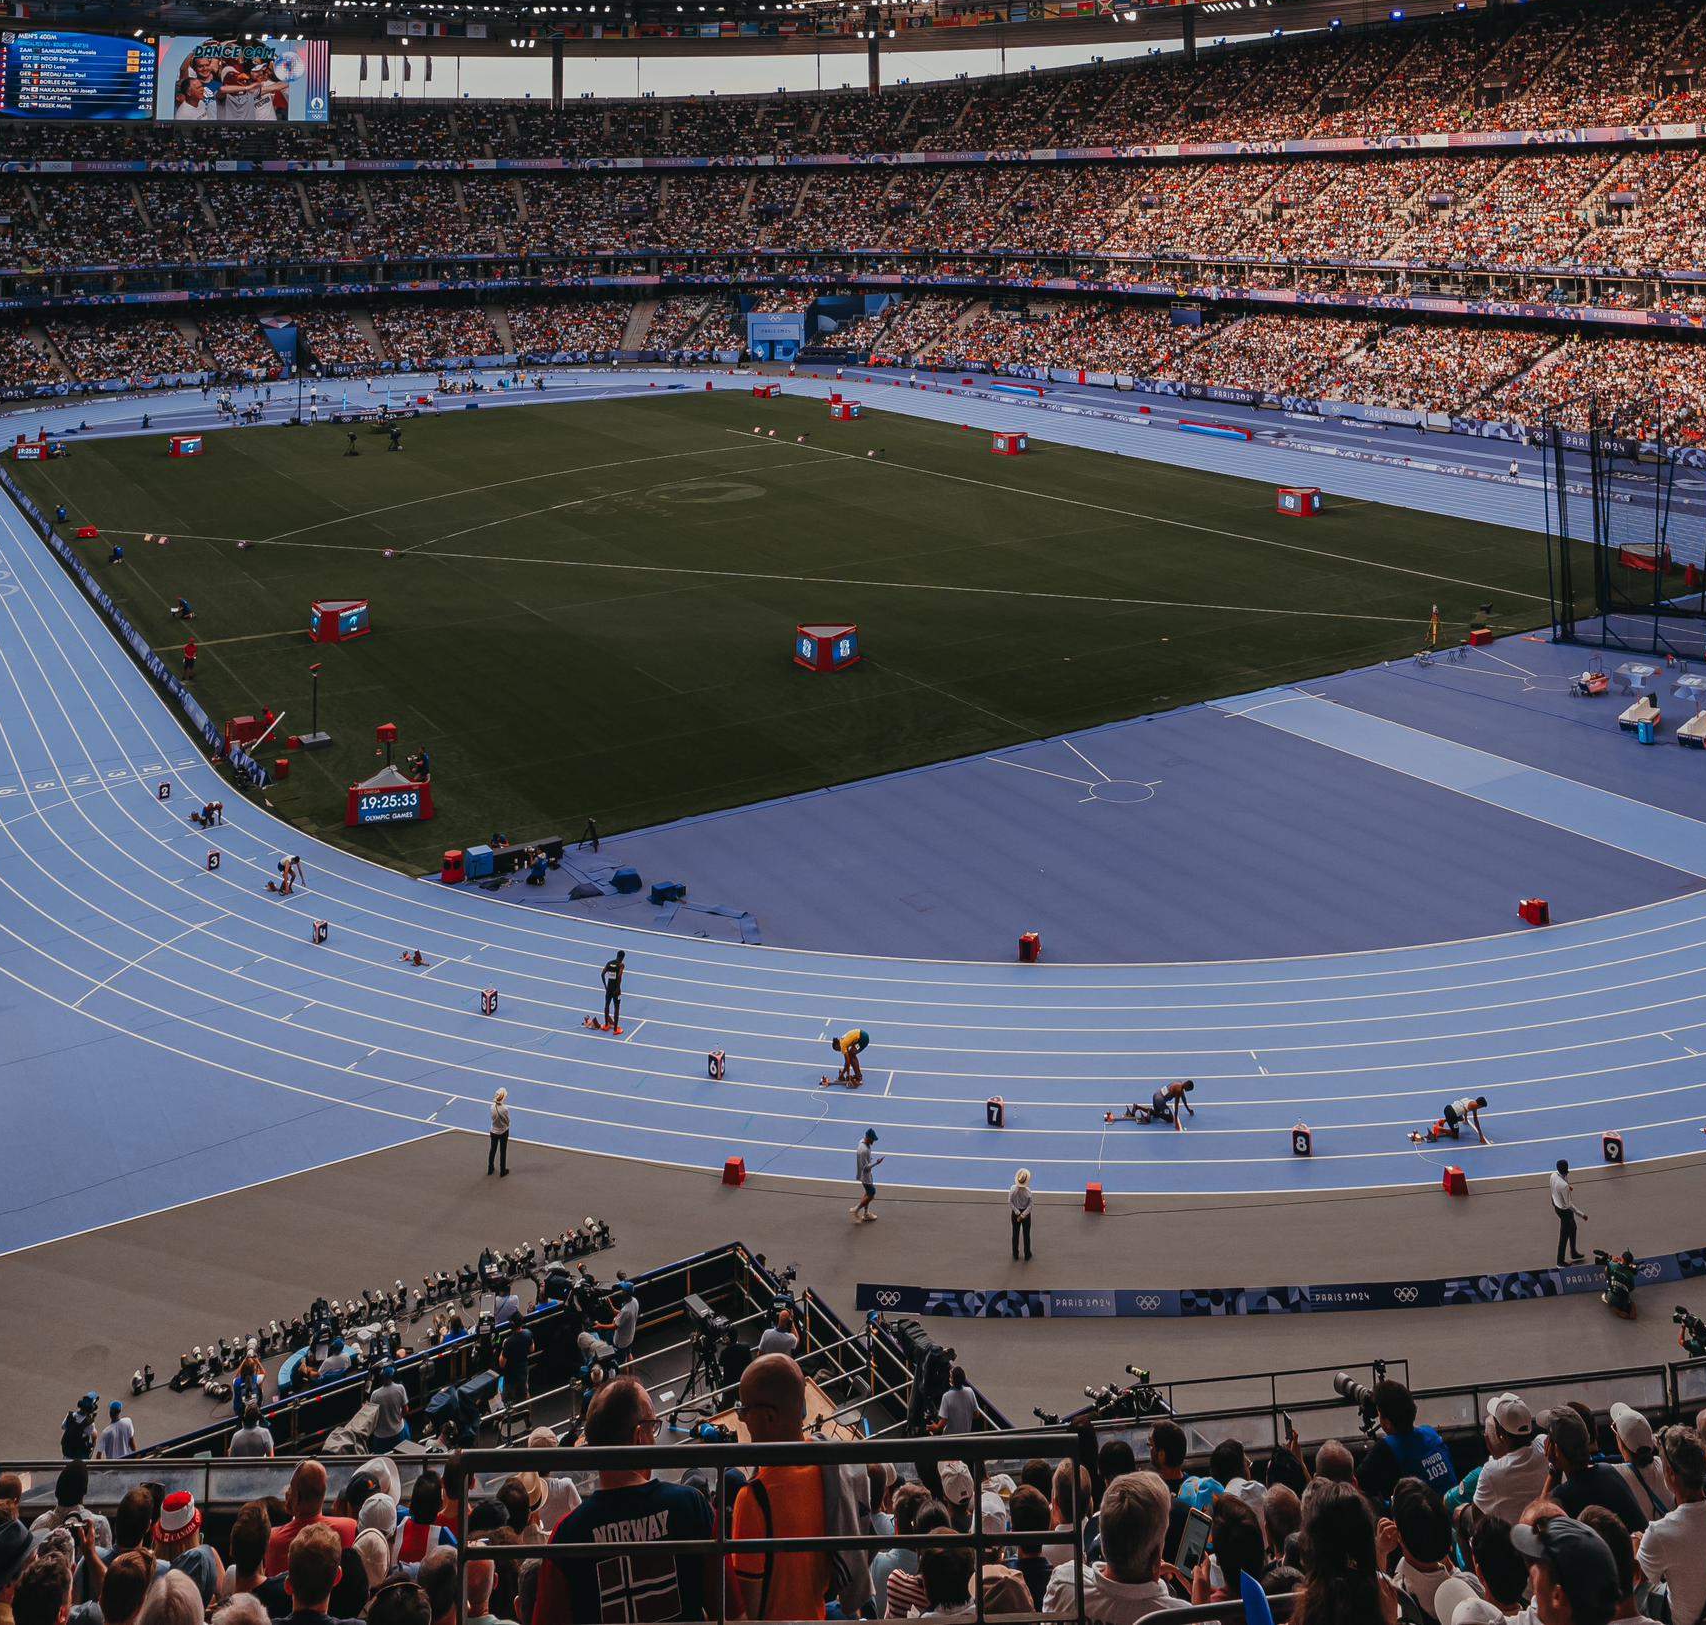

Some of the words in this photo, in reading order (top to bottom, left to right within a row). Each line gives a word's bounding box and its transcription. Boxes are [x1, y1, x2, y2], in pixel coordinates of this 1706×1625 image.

[193, 45, 241, 58] DANCE
[244, 46, 277, 59] CAM
[1421, 301, 1441, 309] PARIS
[1442, 302, 1460, 310] 2024
[1594, 311, 1615, 320] PARIS
[1617, 313, 1636, 321] 2024
[1213, 390, 1235, 399] PARIS
[1236, 392, 1253, 401] 2024
[1364, 409, 1389, 419] PARIS
[1390, 412, 1412, 422] 2024
[161, 786, 169, 797] 2
[360, 792, 418, 811] 19:25:33
[365, 812, 391, 823] OLYMPIC
[391, 811, 414, 821] GAMES
[210, 856, 219, 868] 3
[320, 928, 328, 938] 4
[709, 1060, 718, 1075] 6
[989, 1106, 999, 1122] 7
[1295, 1135, 1308, 1152] 8
[1606, 1142, 1619, 1159] 9
[1565, 1274, 1592, 1286] PARIS
[1055, 1298, 1083, 1308] PARIS
[1085, 1298, 1112, 1308] 2024
[1315, 1293, 1343, 1303] PARIS
[1344, 1292, 1371, 1302] 2024
[1421, 1452, 1443, 1468] PHOTO
[1426, 1462, 1448, 1481] 1033
[592, 1509, 670, 1544] NORWAY
